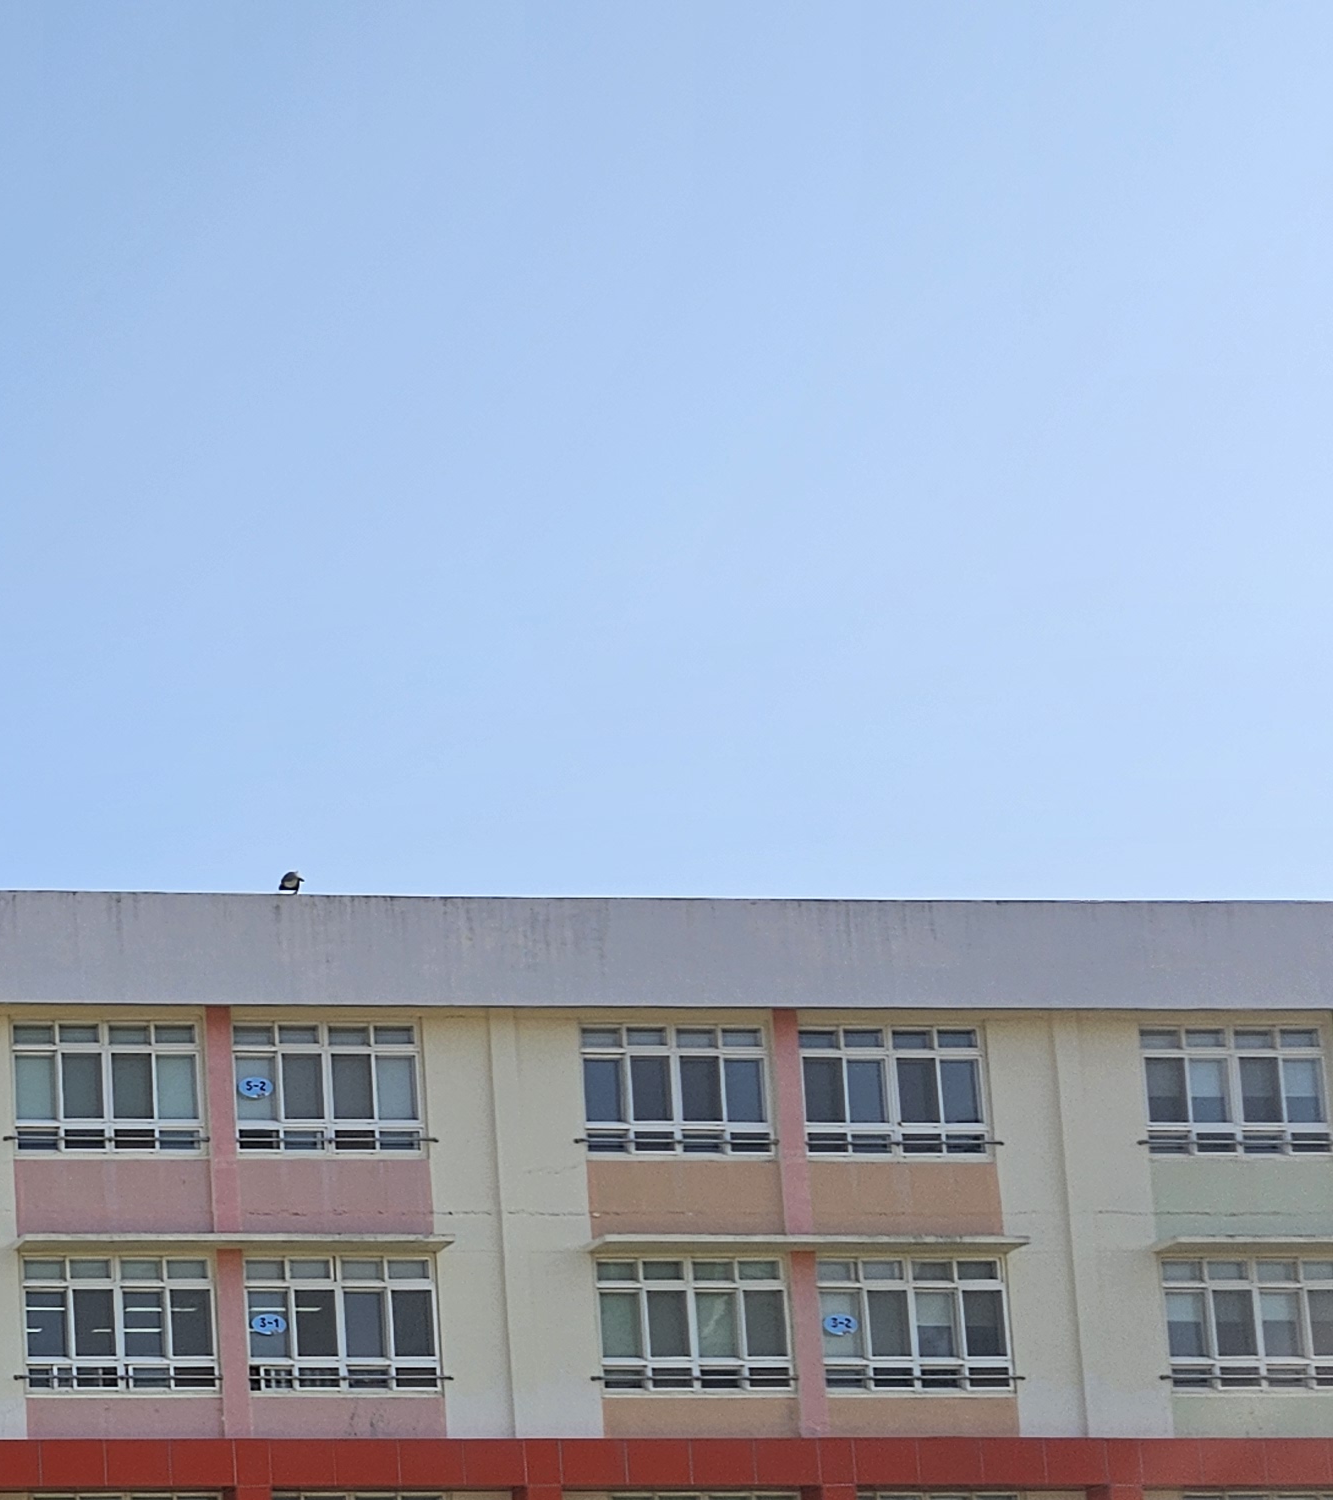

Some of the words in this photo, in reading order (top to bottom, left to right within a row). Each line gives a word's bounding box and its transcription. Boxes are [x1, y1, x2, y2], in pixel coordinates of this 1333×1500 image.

[246, 1080, 266, 1091] 5-2
[259, 1317, 279, 1328] 3-1
[831, 1317, 851, 1329] 3-2
